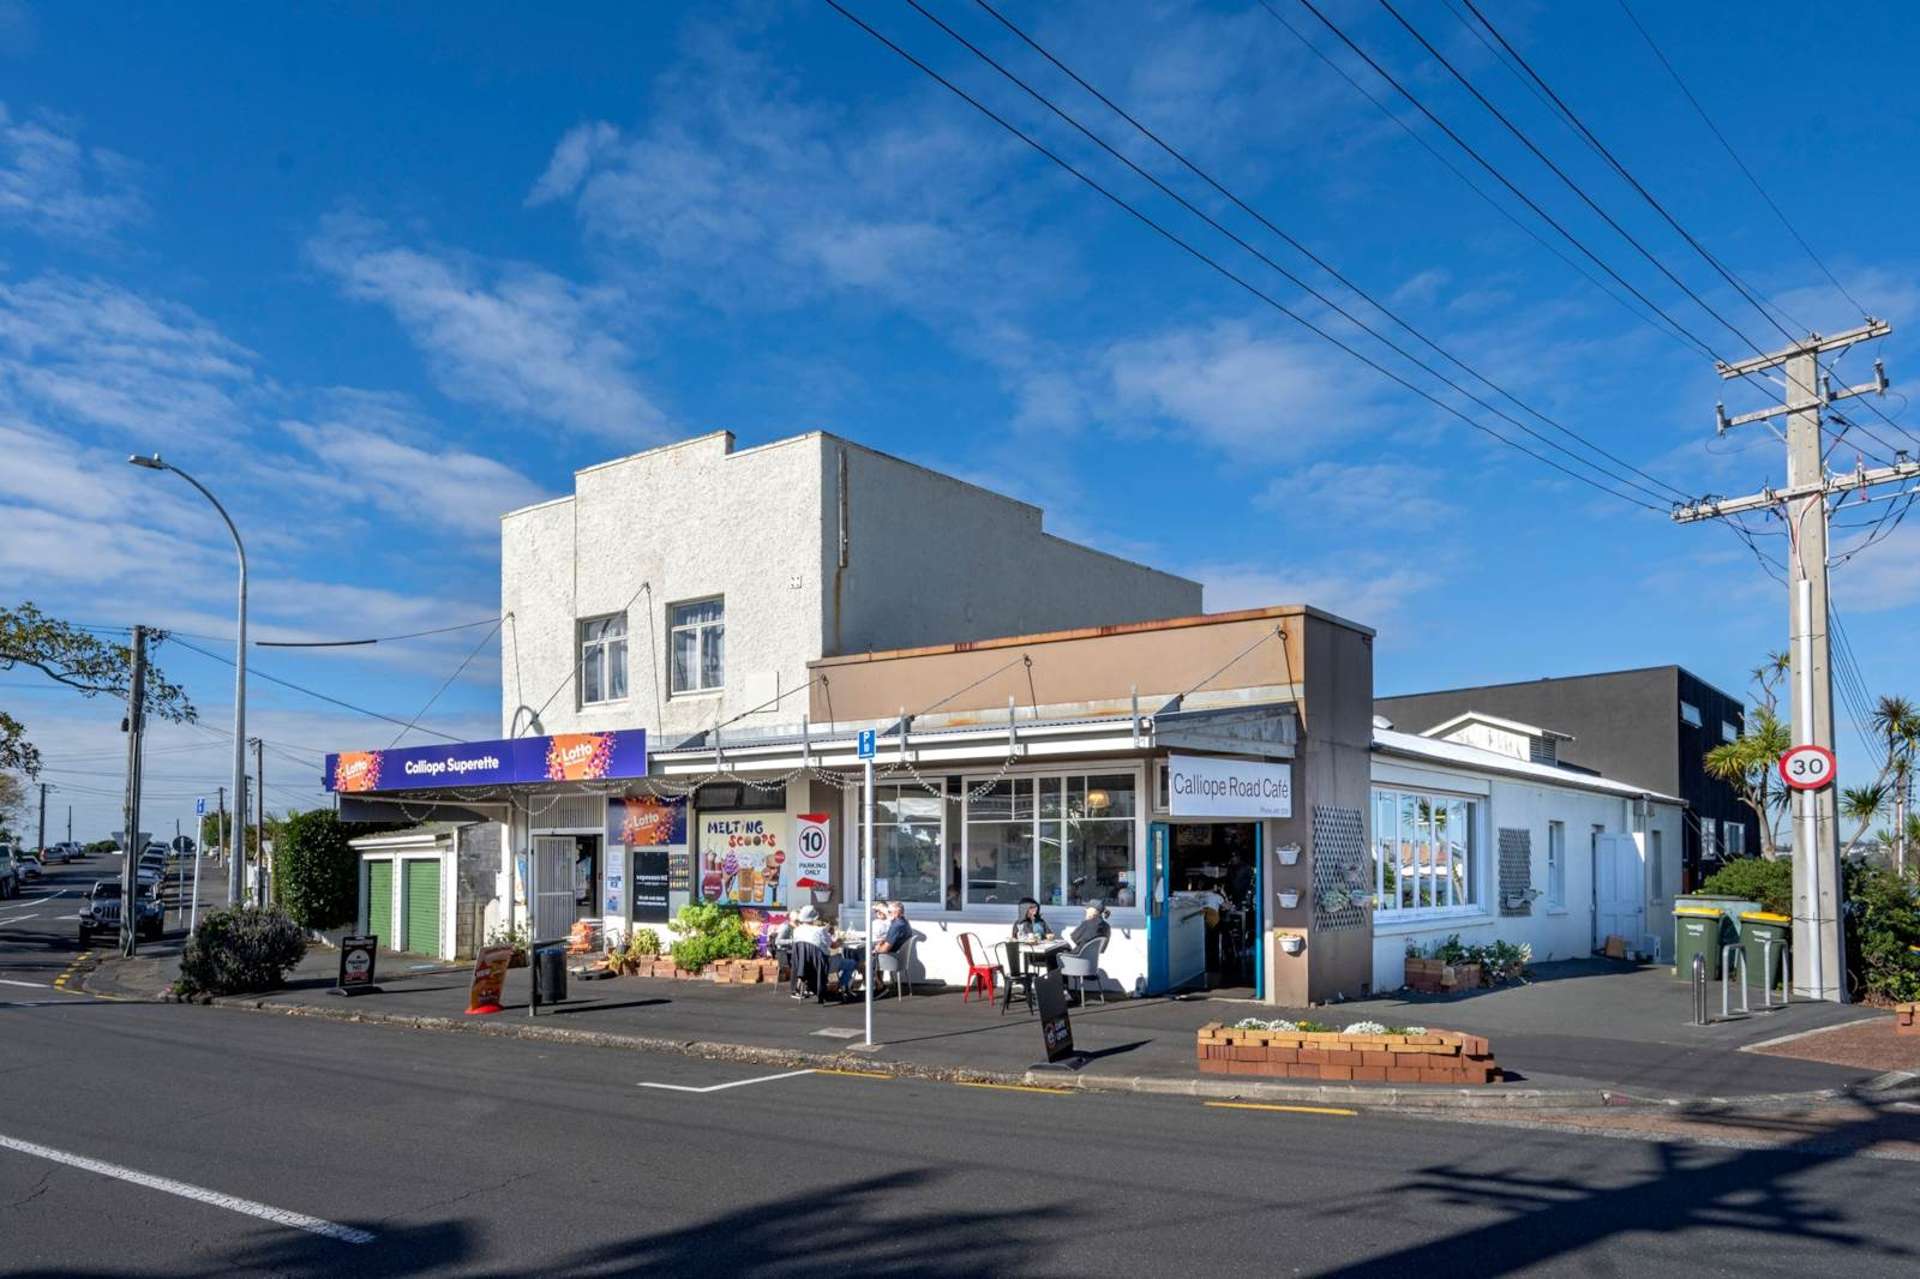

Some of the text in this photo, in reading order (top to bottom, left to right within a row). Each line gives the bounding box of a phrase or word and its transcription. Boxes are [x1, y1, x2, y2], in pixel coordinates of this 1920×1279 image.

[561, 744, 592, 761] Lotto
[345, 760, 367, 775] Lotto
[405, 756, 499, 776] Calliope Superette
[1793, 758, 1823, 775] 30
[1174, 773, 1289, 800] Calliope Road Café
[633, 813, 659, 827] Lotto
[707, 820, 764, 834] MELTING
[728, 834, 776, 848] SCOOPS
[802, 832, 823, 852] 10
